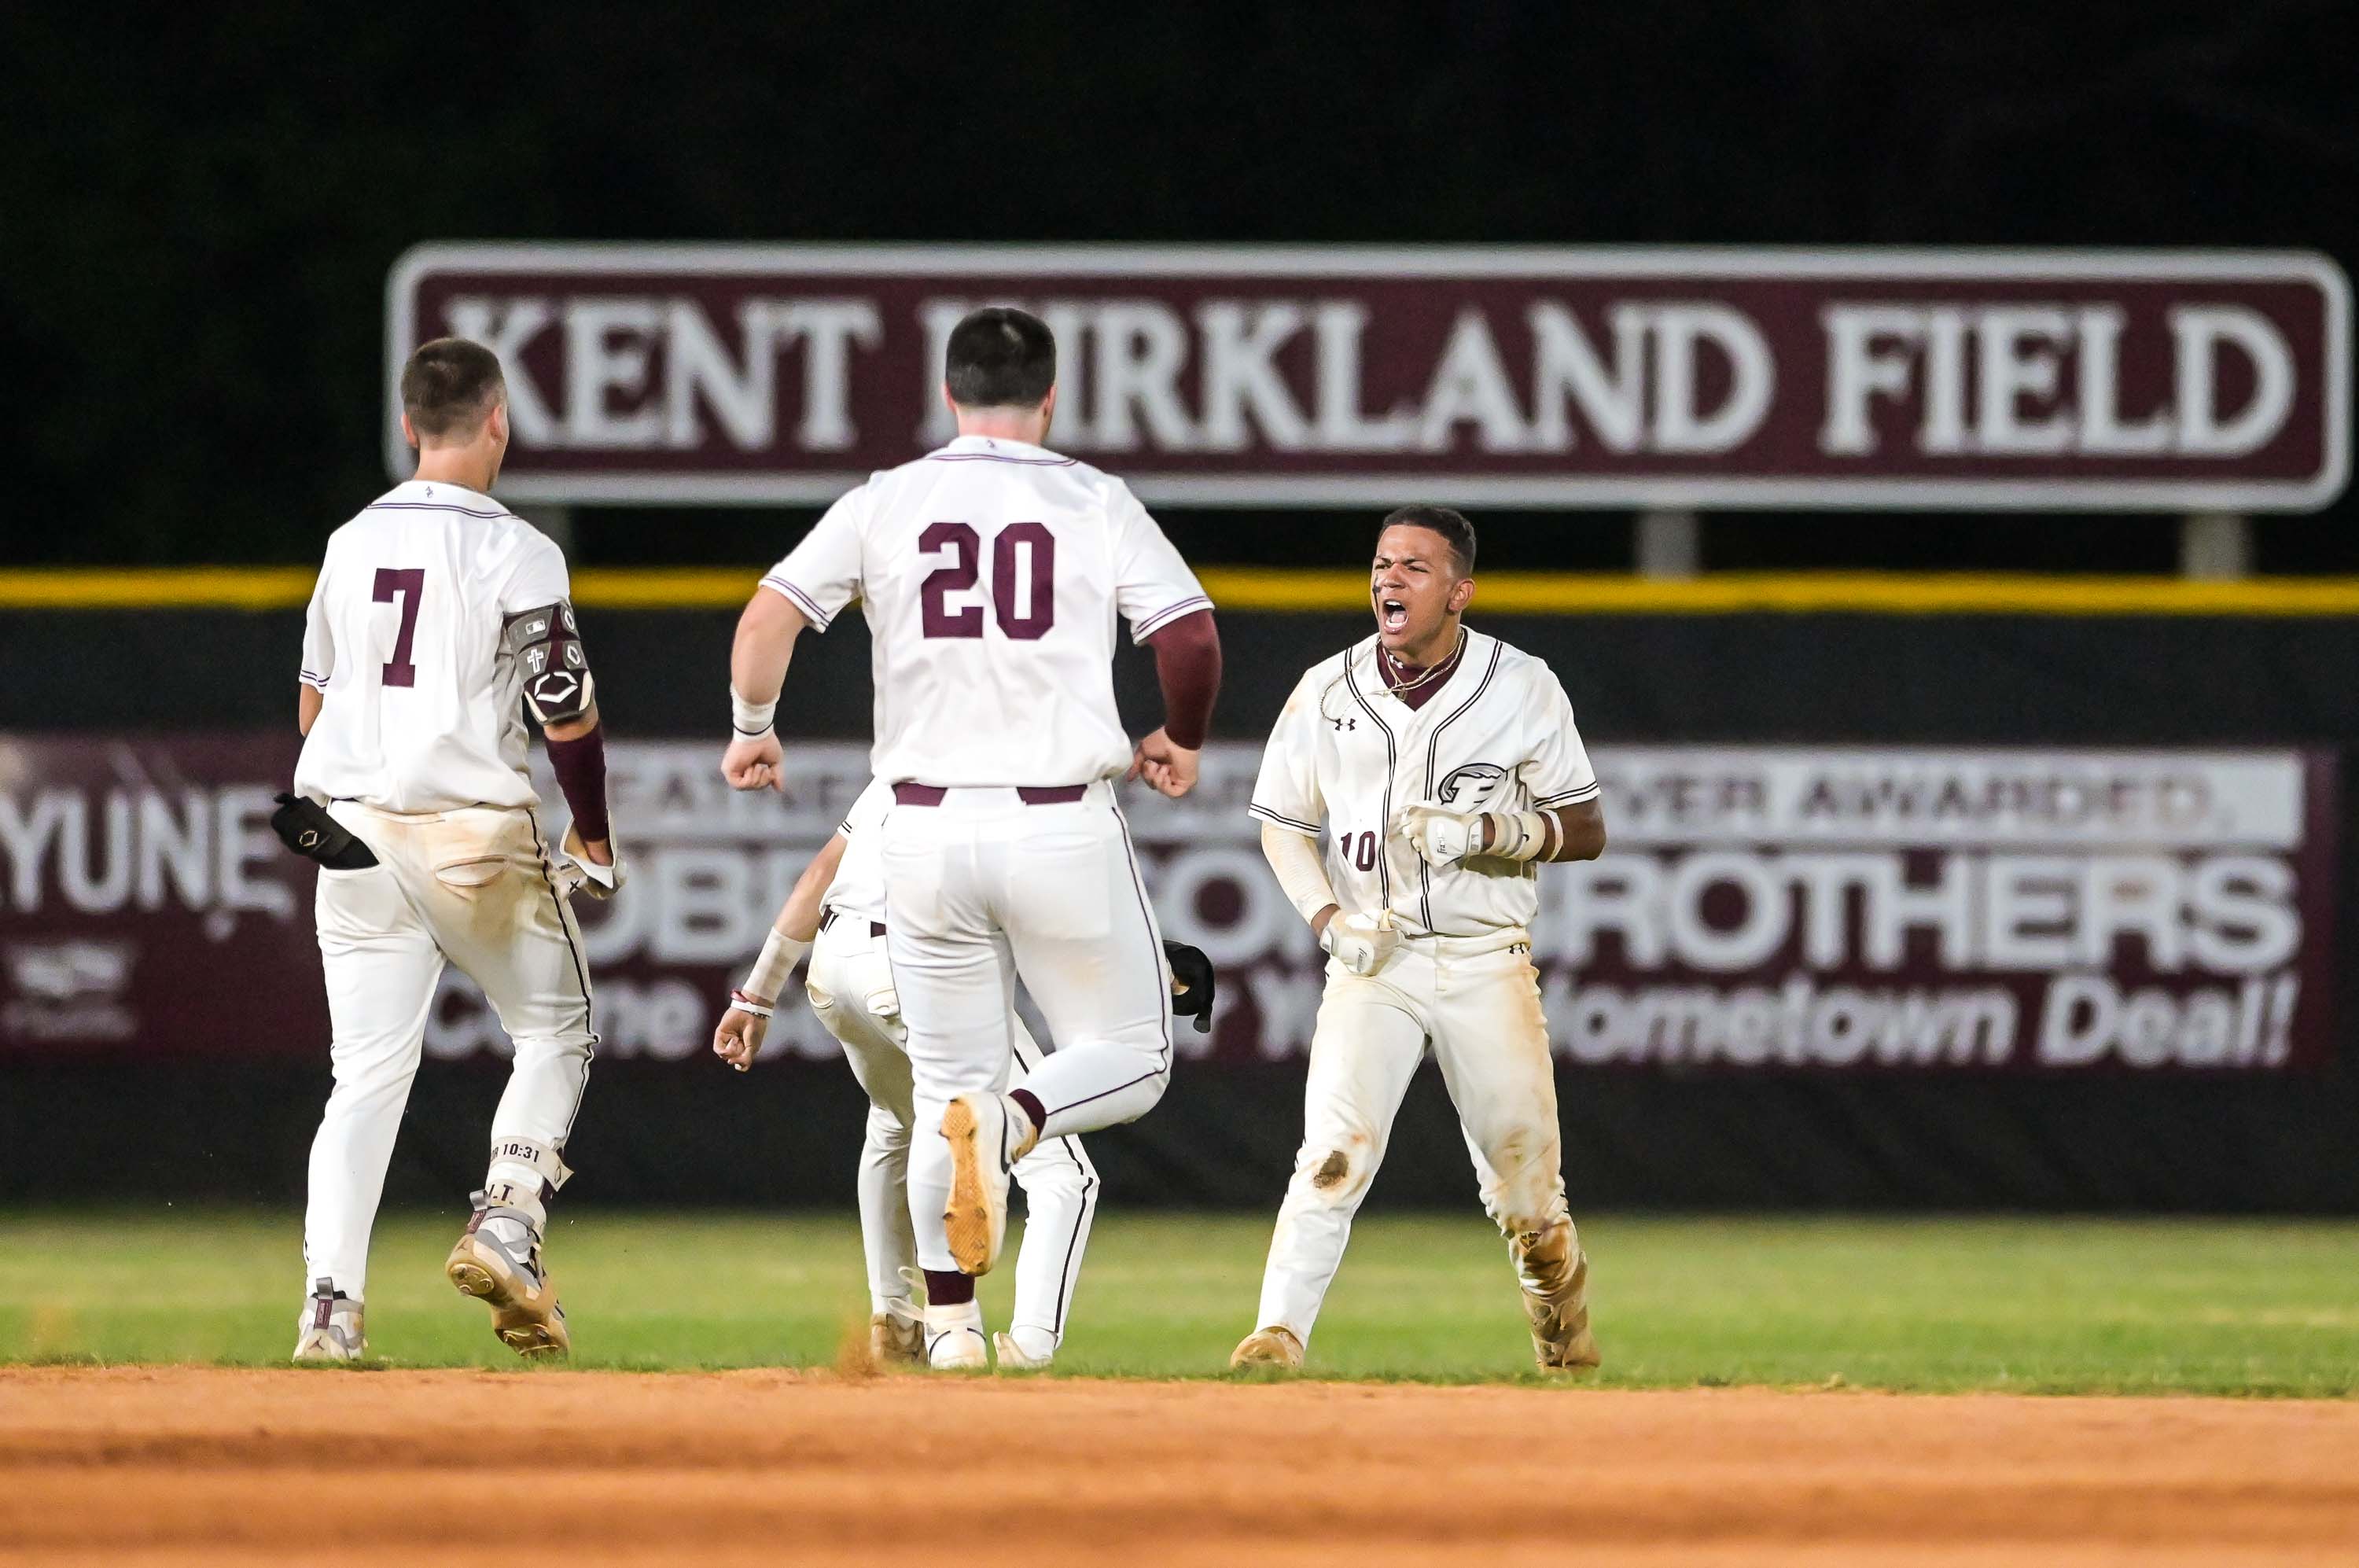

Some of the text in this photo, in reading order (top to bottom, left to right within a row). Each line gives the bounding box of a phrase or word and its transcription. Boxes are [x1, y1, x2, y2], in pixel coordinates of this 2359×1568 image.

[442, 294, 2299, 459] KENT IRKLAND FIELD
[372, 568, 425, 688] 7
[918, 522, 1054, 640] 20
[0, 785, 296, 918] YUNE
[1340, 830, 1376, 872] 10
[1536, 853, 2302, 975] ROTHERS
[1544, 971, 2019, 1064] ometown
[2038, 971, 2301, 1067] Deal!
[503, 1143, 539, 1163] 10:31
